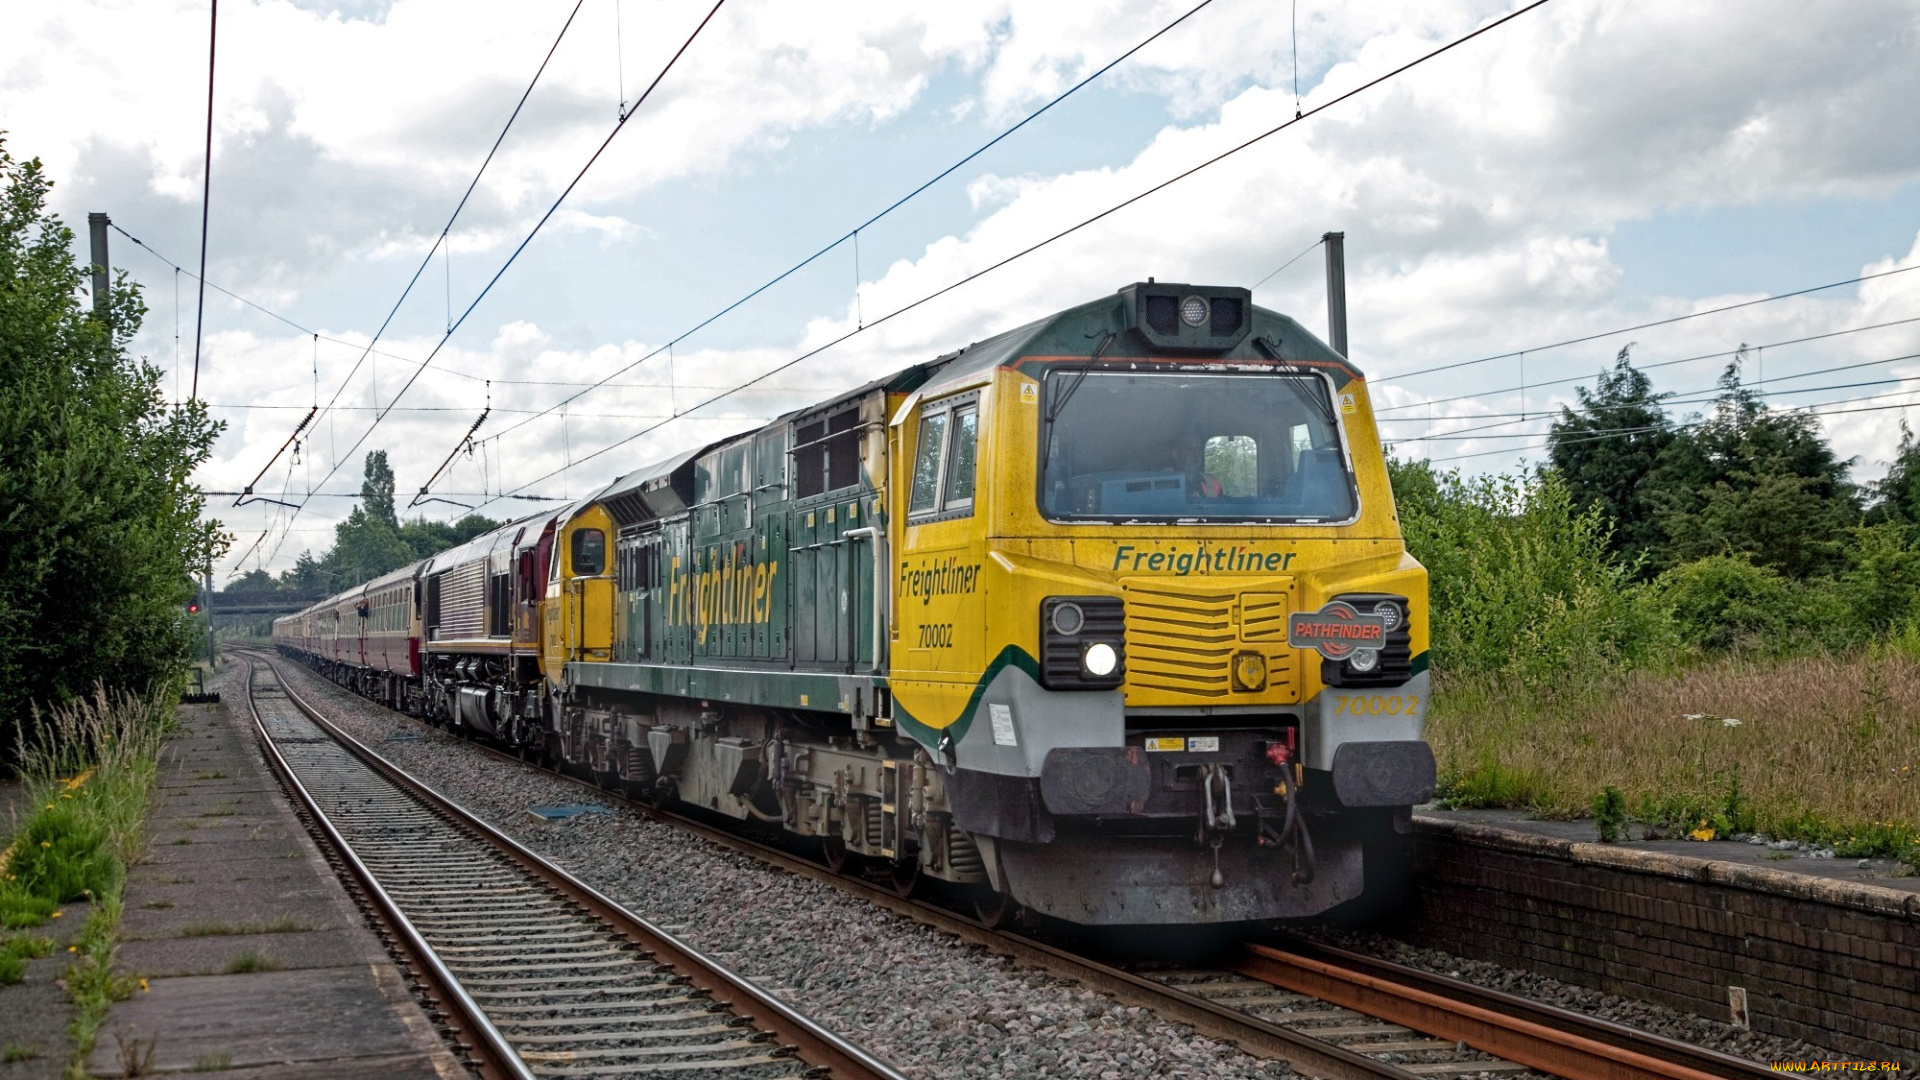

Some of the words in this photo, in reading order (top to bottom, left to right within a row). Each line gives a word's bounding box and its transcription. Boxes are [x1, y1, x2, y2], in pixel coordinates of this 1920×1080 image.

[1113, 546, 1297, 577] Freightliner
[899, 556, 981, 606] Freightliner
[919, 623, 953, 648] 70002
[1295, 622, 1382, 639] PATHFINDER
[1335, 695, 1419, 716] 70002
